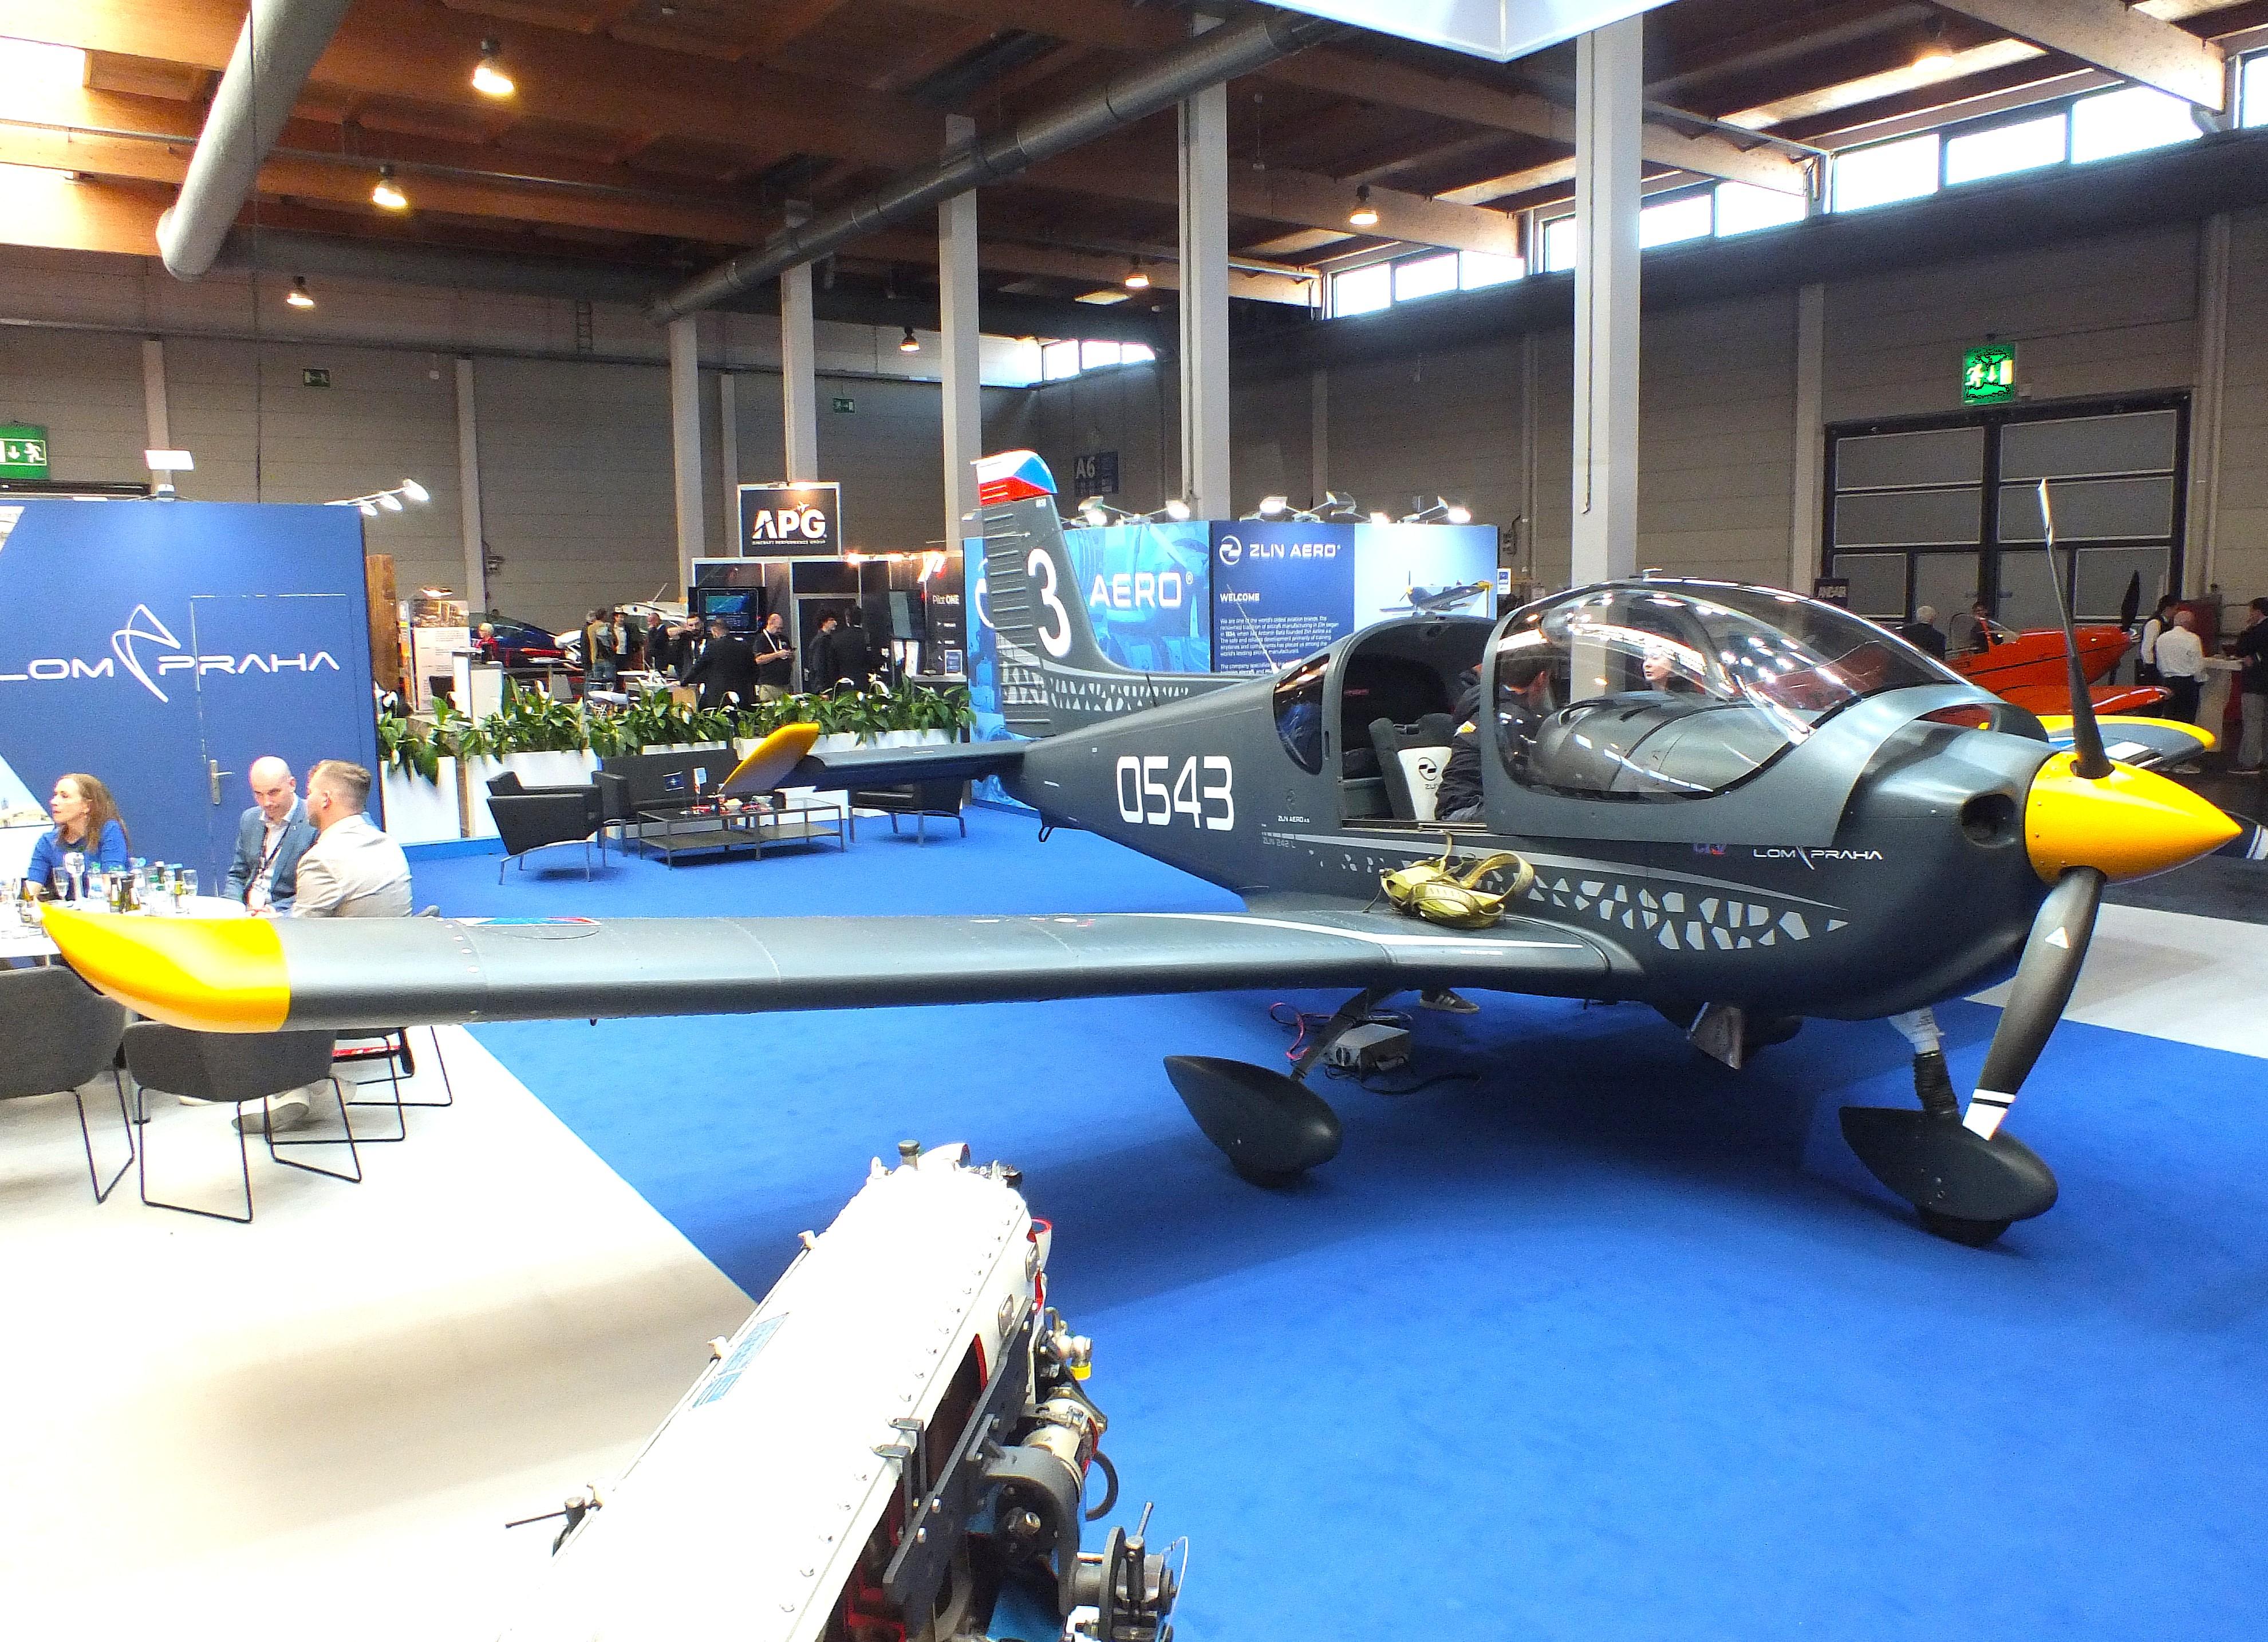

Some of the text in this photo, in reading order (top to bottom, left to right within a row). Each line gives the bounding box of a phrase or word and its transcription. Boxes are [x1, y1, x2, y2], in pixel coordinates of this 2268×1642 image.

[1076, 456, 1095, 477] A6
[752, 509, 826, 539] APG
[1249, 544, 1285, 557] ZLIN
[946, 594, 960, 604] ONE
[1028, 548, 1071, 657] 3
[1220, 593, 1260, 602] WELCOME
[159, 651, 340, 675] PRAHA
[1117, 756, 1234, 831] 0543
[1753, 849, 1883, 860] LOM PRAHA
